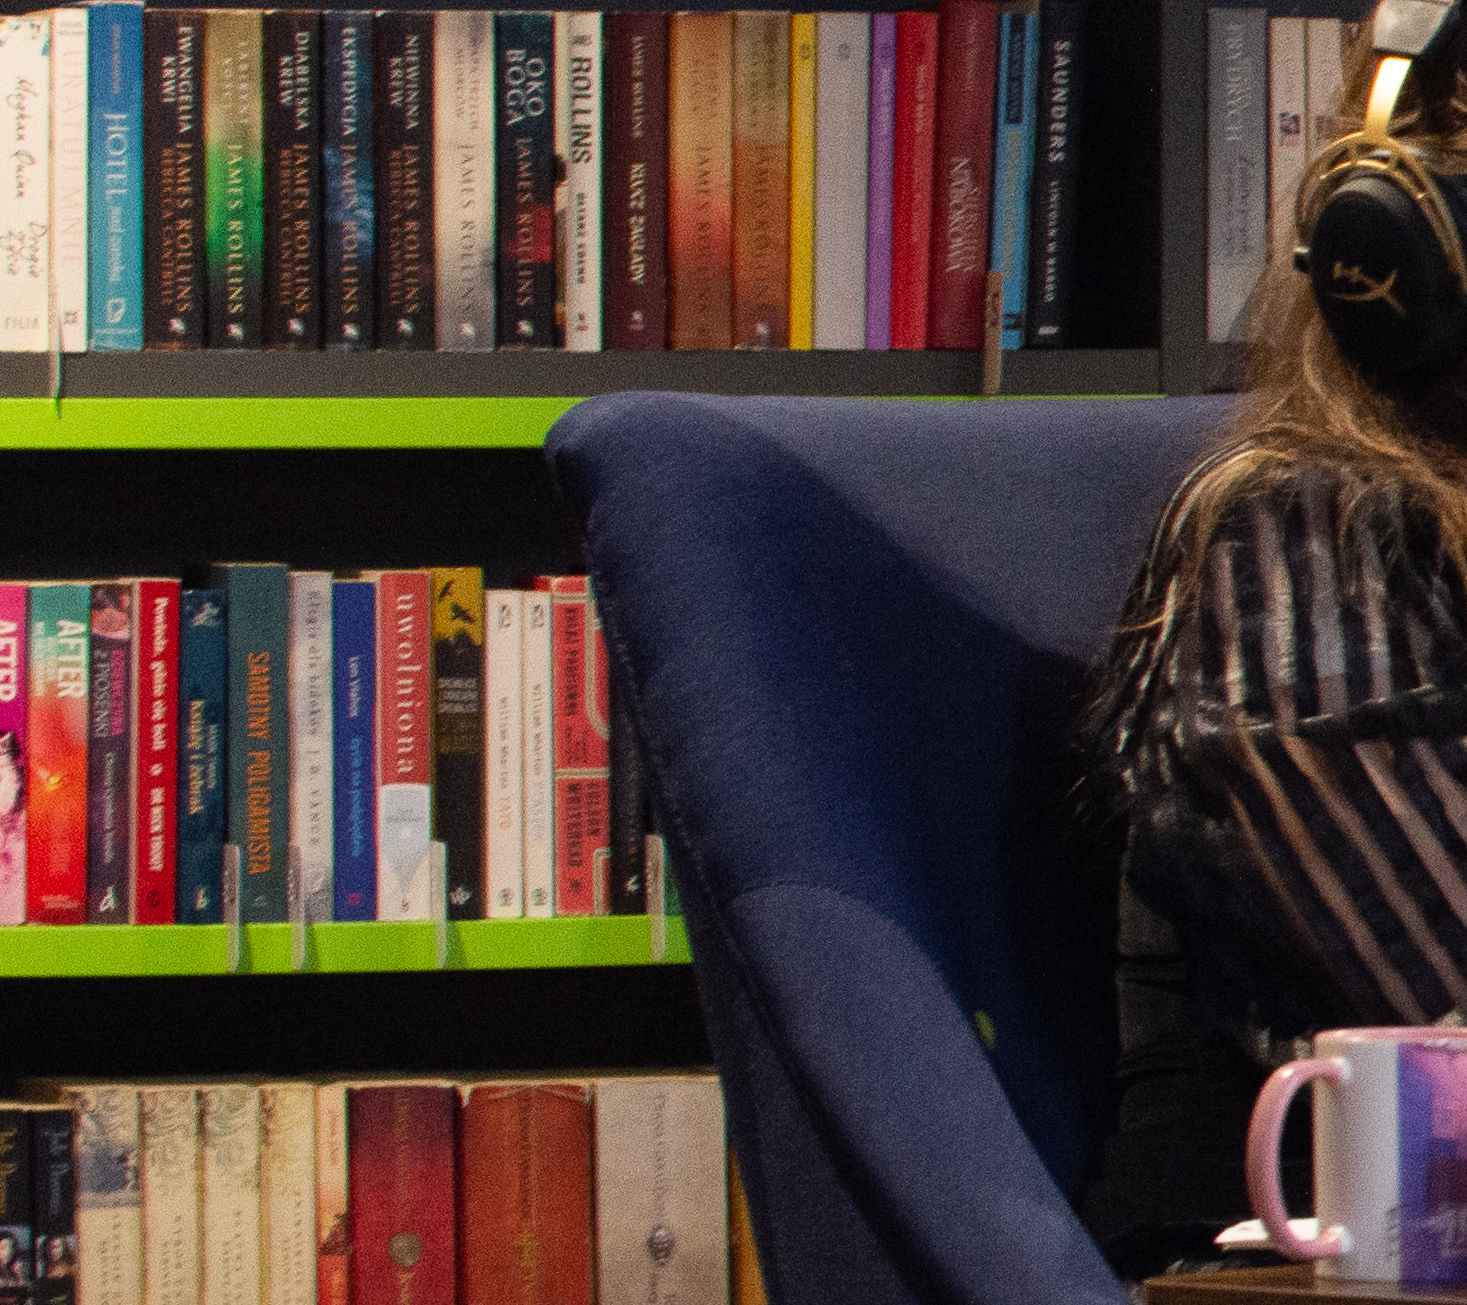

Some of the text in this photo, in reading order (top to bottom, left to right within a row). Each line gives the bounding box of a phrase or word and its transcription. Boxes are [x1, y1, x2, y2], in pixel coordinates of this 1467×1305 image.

[177, 26, 192, 132] EWANGELIA
[279, 56, 292, 106] KREW
[295, 32, 309, 130] DIABELSKA
[342, 28, 356, 137] EKSPEDYCJA
[405, 35, 418, 130] NIEWINNA
[506, 49, 525, 125] BOGA
[525, 58, 546, 117] OKO
[104, 113, 127, 200] HOTEL
[515, 137, 531, 306] JAMES ROLLINS
[175, 143, 192, 312] JAMES ROLLINS
[227, 145, 243, 314] JAMES ROLLINS
[293, 145, 309, 313] JAMES ROLLINS
[340, 145, 357, 314] JAMES ROLLINS
[403, 147, 418, 314] JAMES ROLLINS
[460, 146, 480, 313] JAMES ROLLINS
[56, 620, 86, 698] AFTER
[396, 595, 422, 774] uwolniona
[246, 652, 271, 874] SAMOTNY POLIGAMISTA
